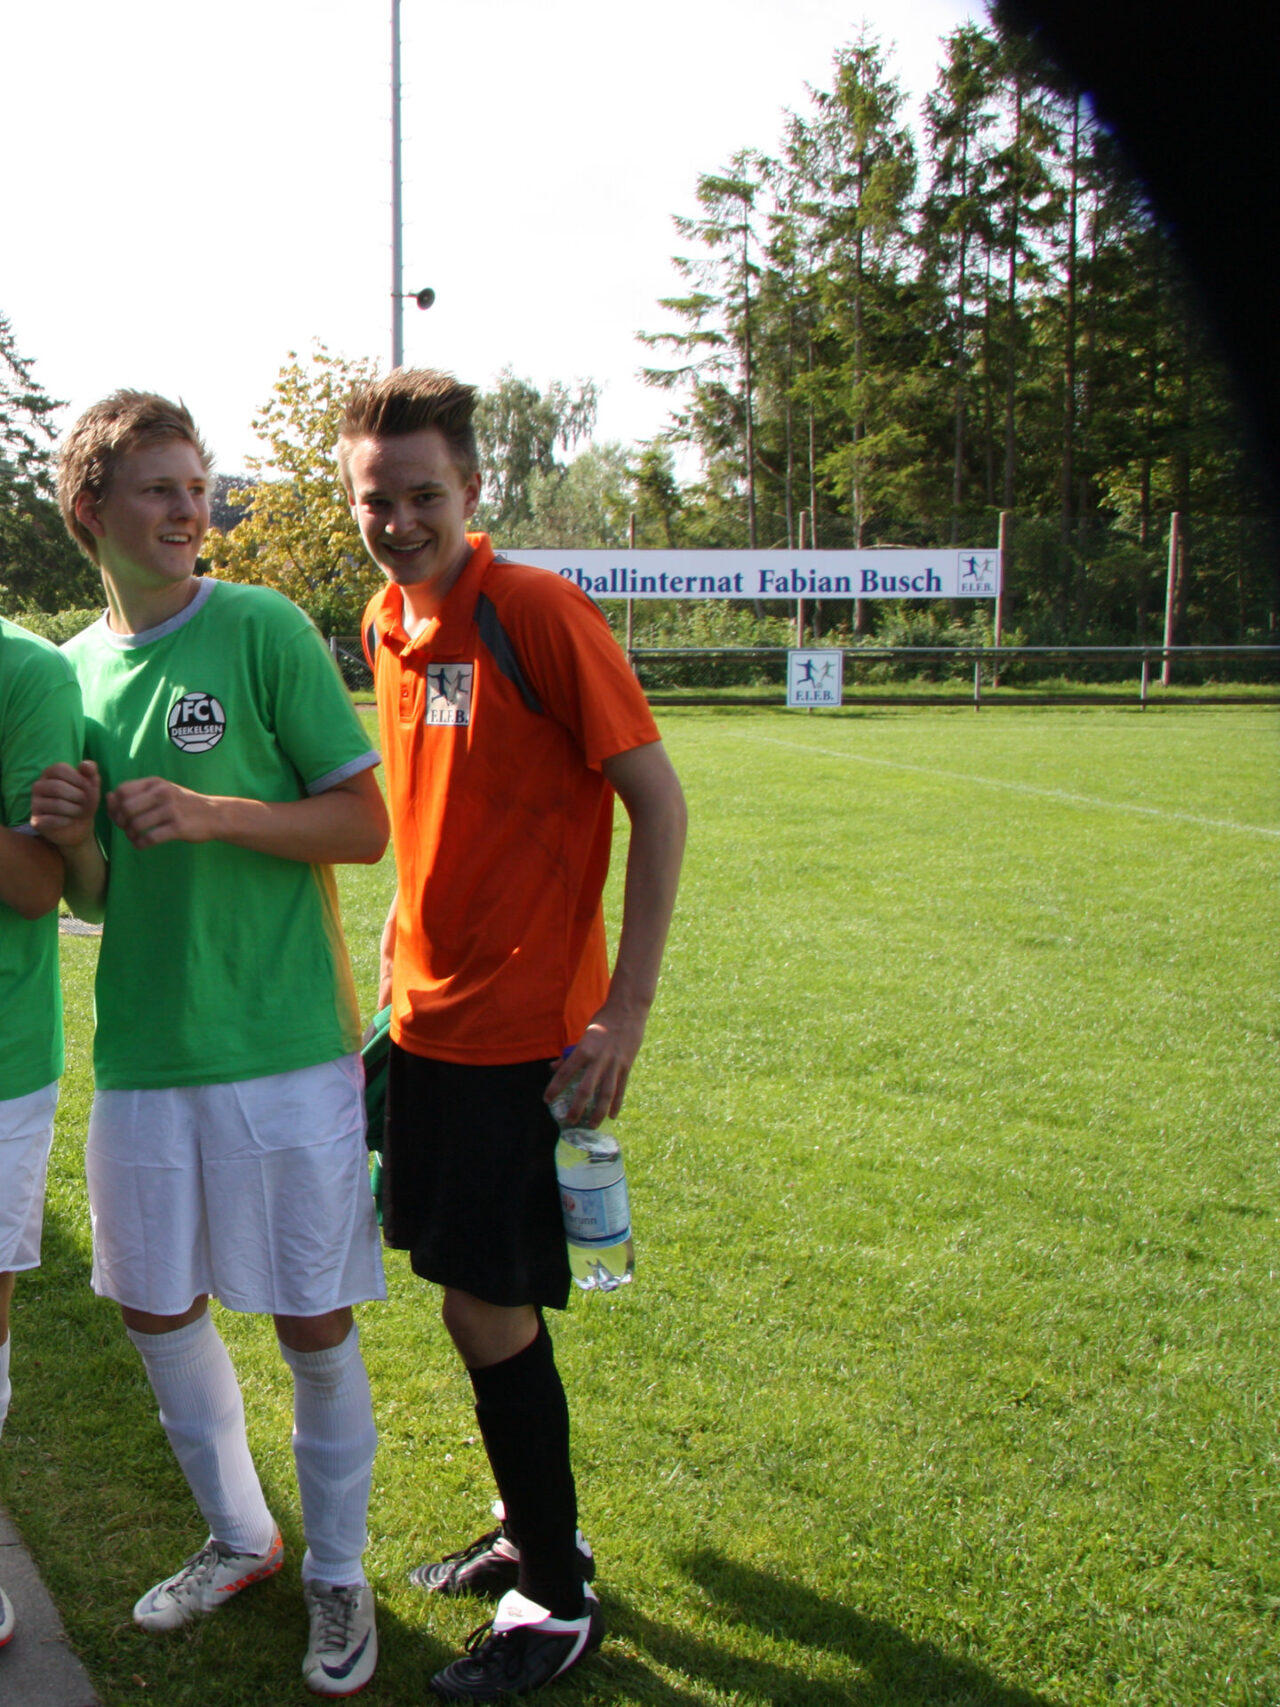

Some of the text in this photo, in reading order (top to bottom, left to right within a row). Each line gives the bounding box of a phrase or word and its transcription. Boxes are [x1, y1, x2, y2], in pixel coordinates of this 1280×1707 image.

[758, 568, 851, 593] Fabian
[860, 567, 943, 593] Busch
[182, 700, 210, 723] FC
[171, 724, 223, 737] DEEKELSEN
